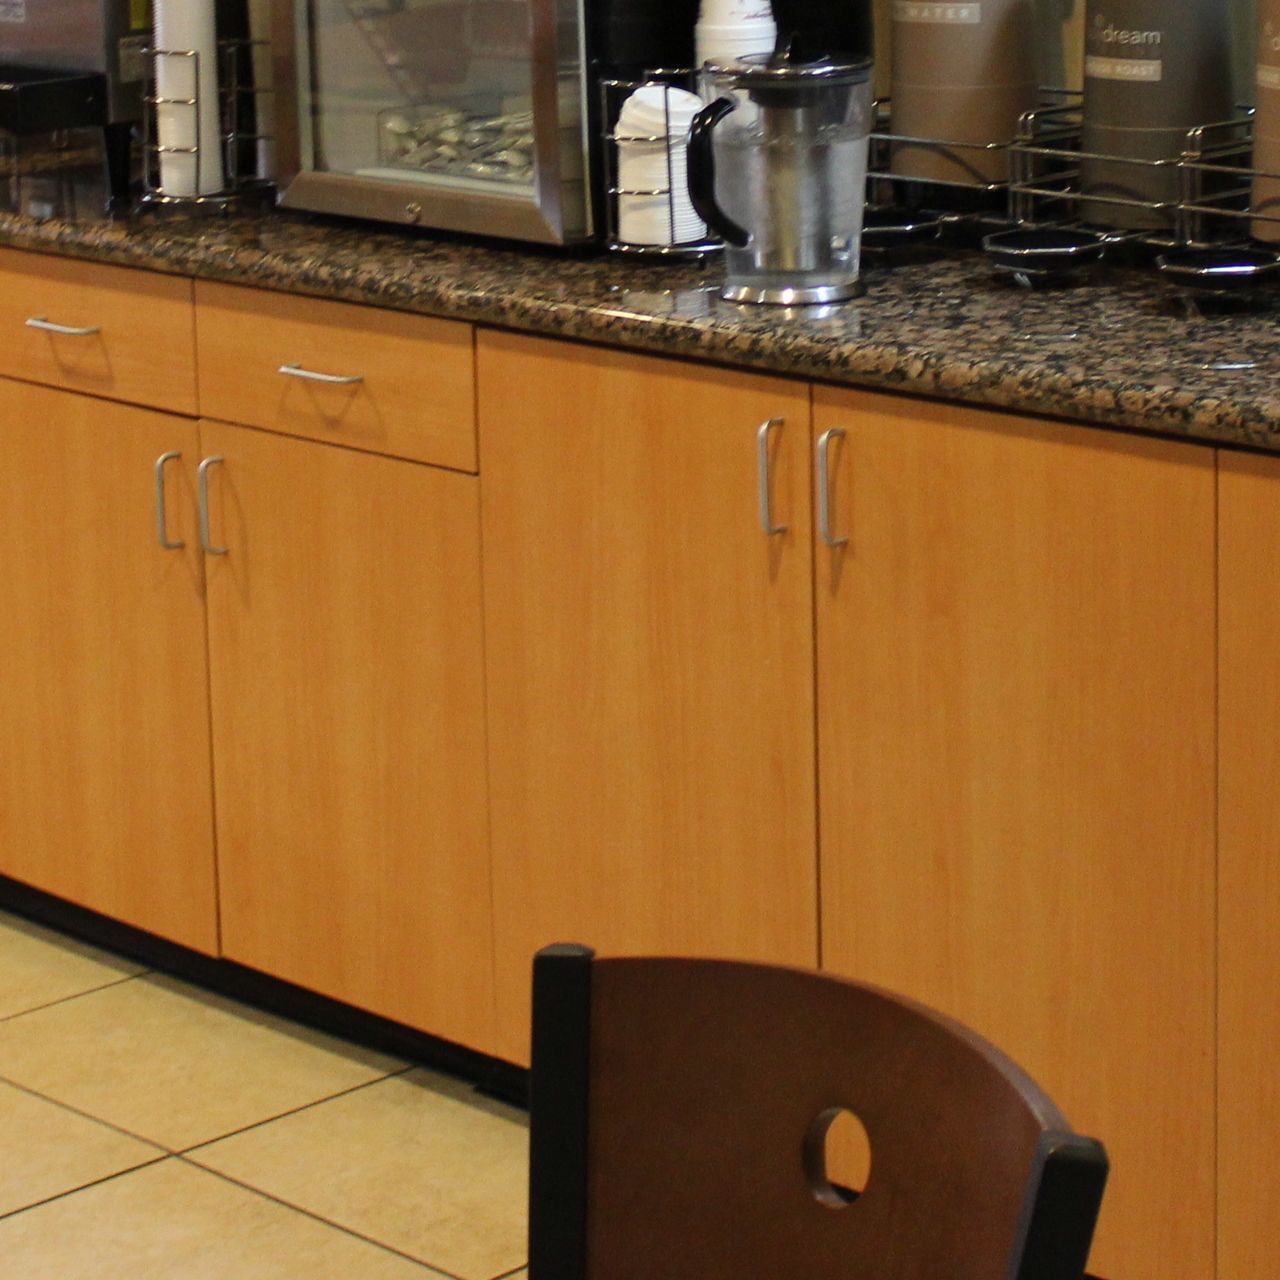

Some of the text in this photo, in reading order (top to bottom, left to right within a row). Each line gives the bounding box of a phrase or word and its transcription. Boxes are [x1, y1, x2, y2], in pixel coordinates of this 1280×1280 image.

[905, 6, 970, 20] WATER
[1103, 23, 1161, 45] dream
[1114, 64, 1156, 77] ROAST
